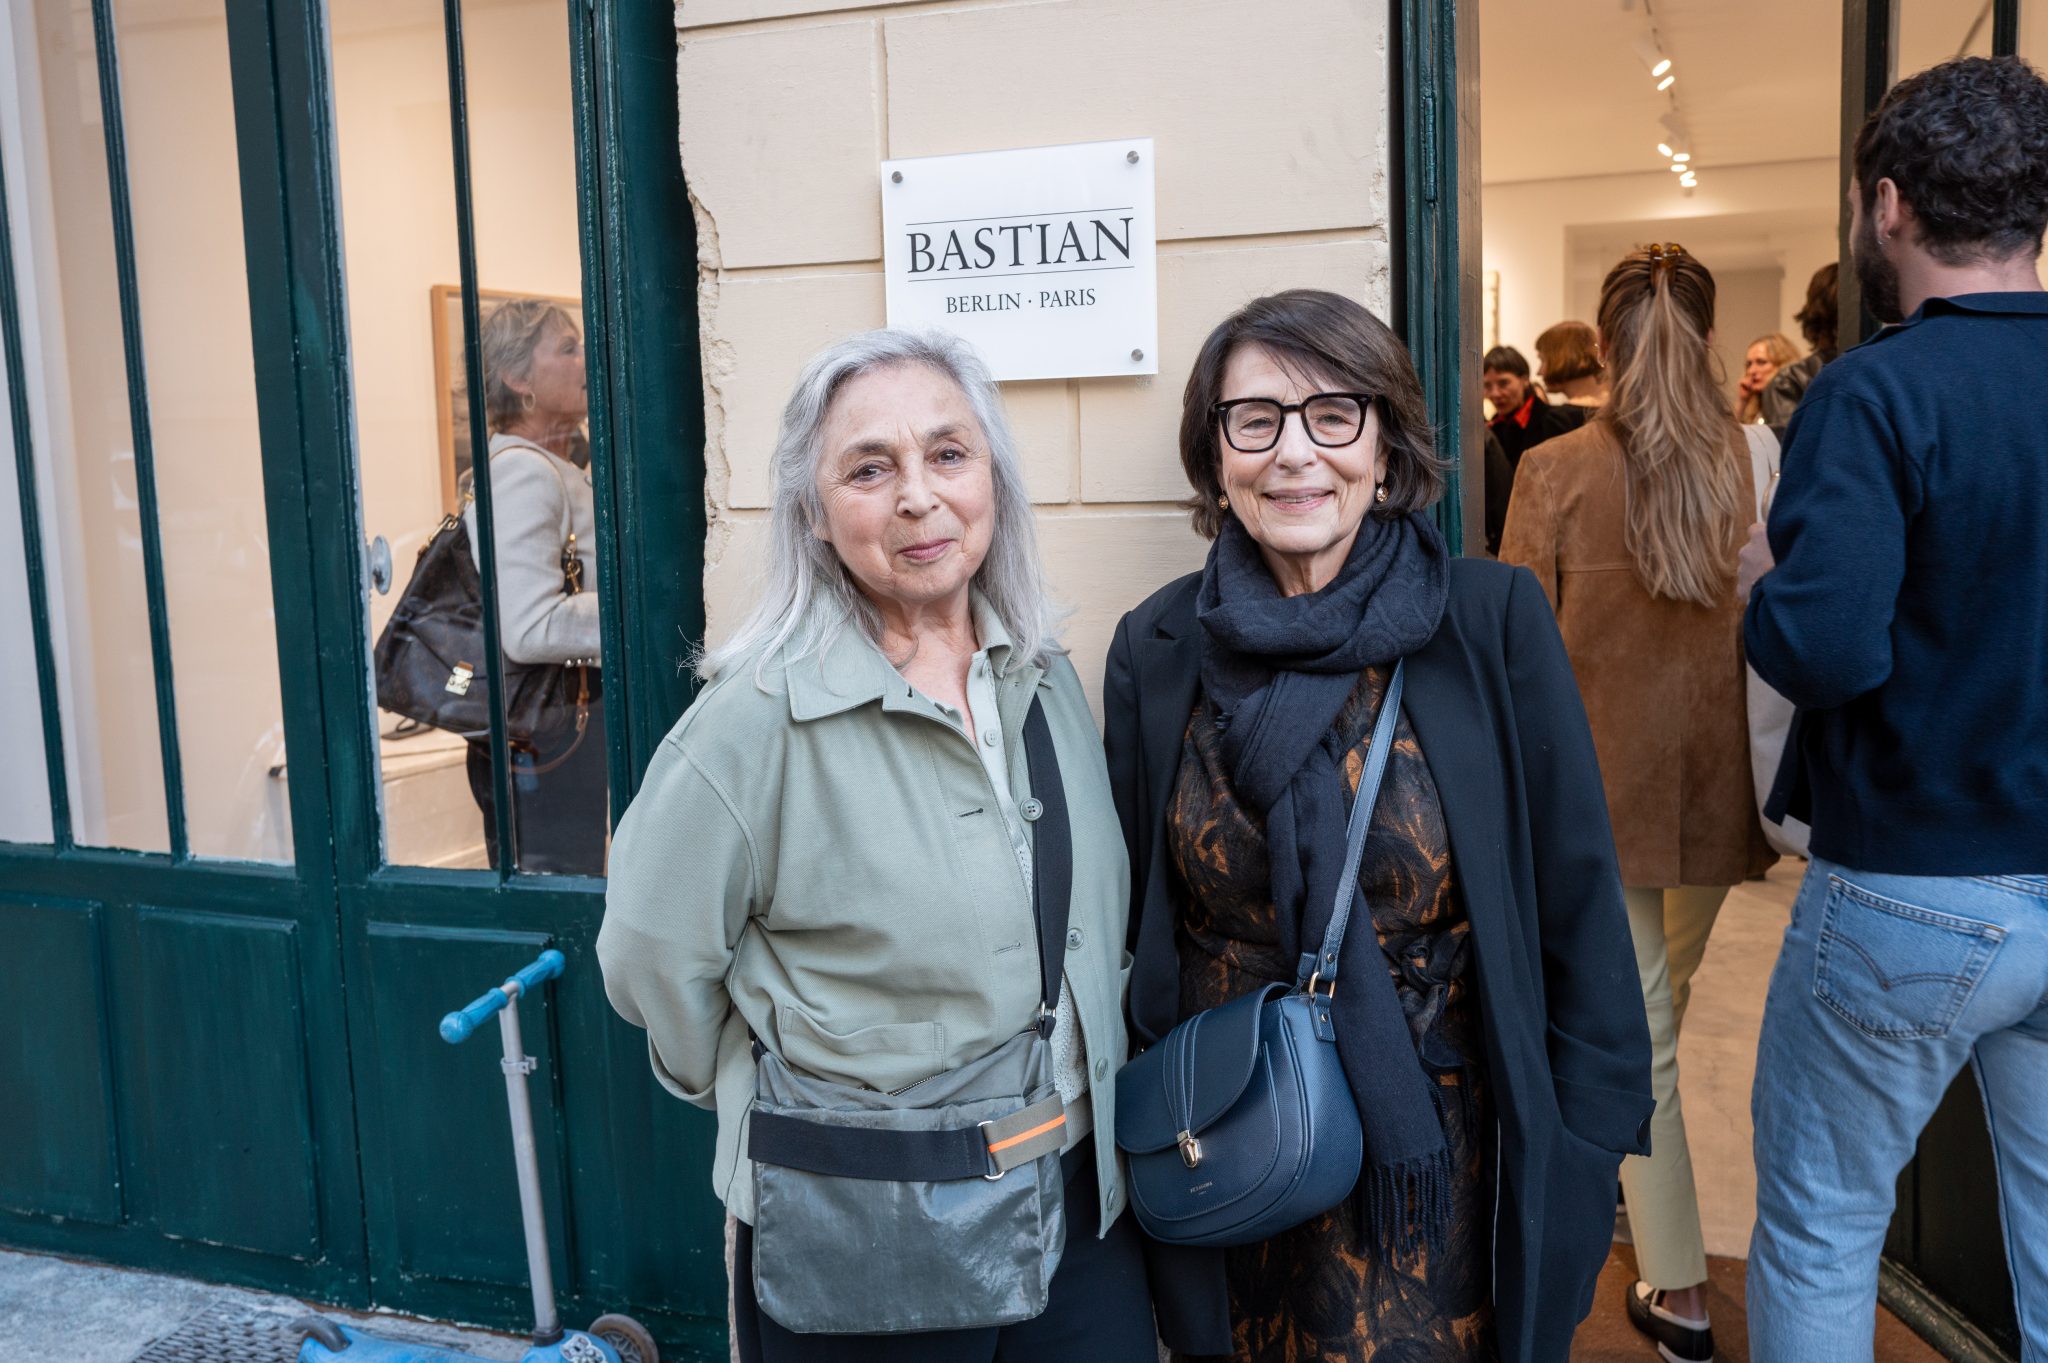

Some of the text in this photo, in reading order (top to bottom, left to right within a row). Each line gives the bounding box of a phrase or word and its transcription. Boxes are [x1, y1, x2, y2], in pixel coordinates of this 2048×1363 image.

[906, 217, 1134, 274] BASTIAN
[946, 292, 1021, 314] BERLIN
[1039, 288, 1096, 308] PARIS
